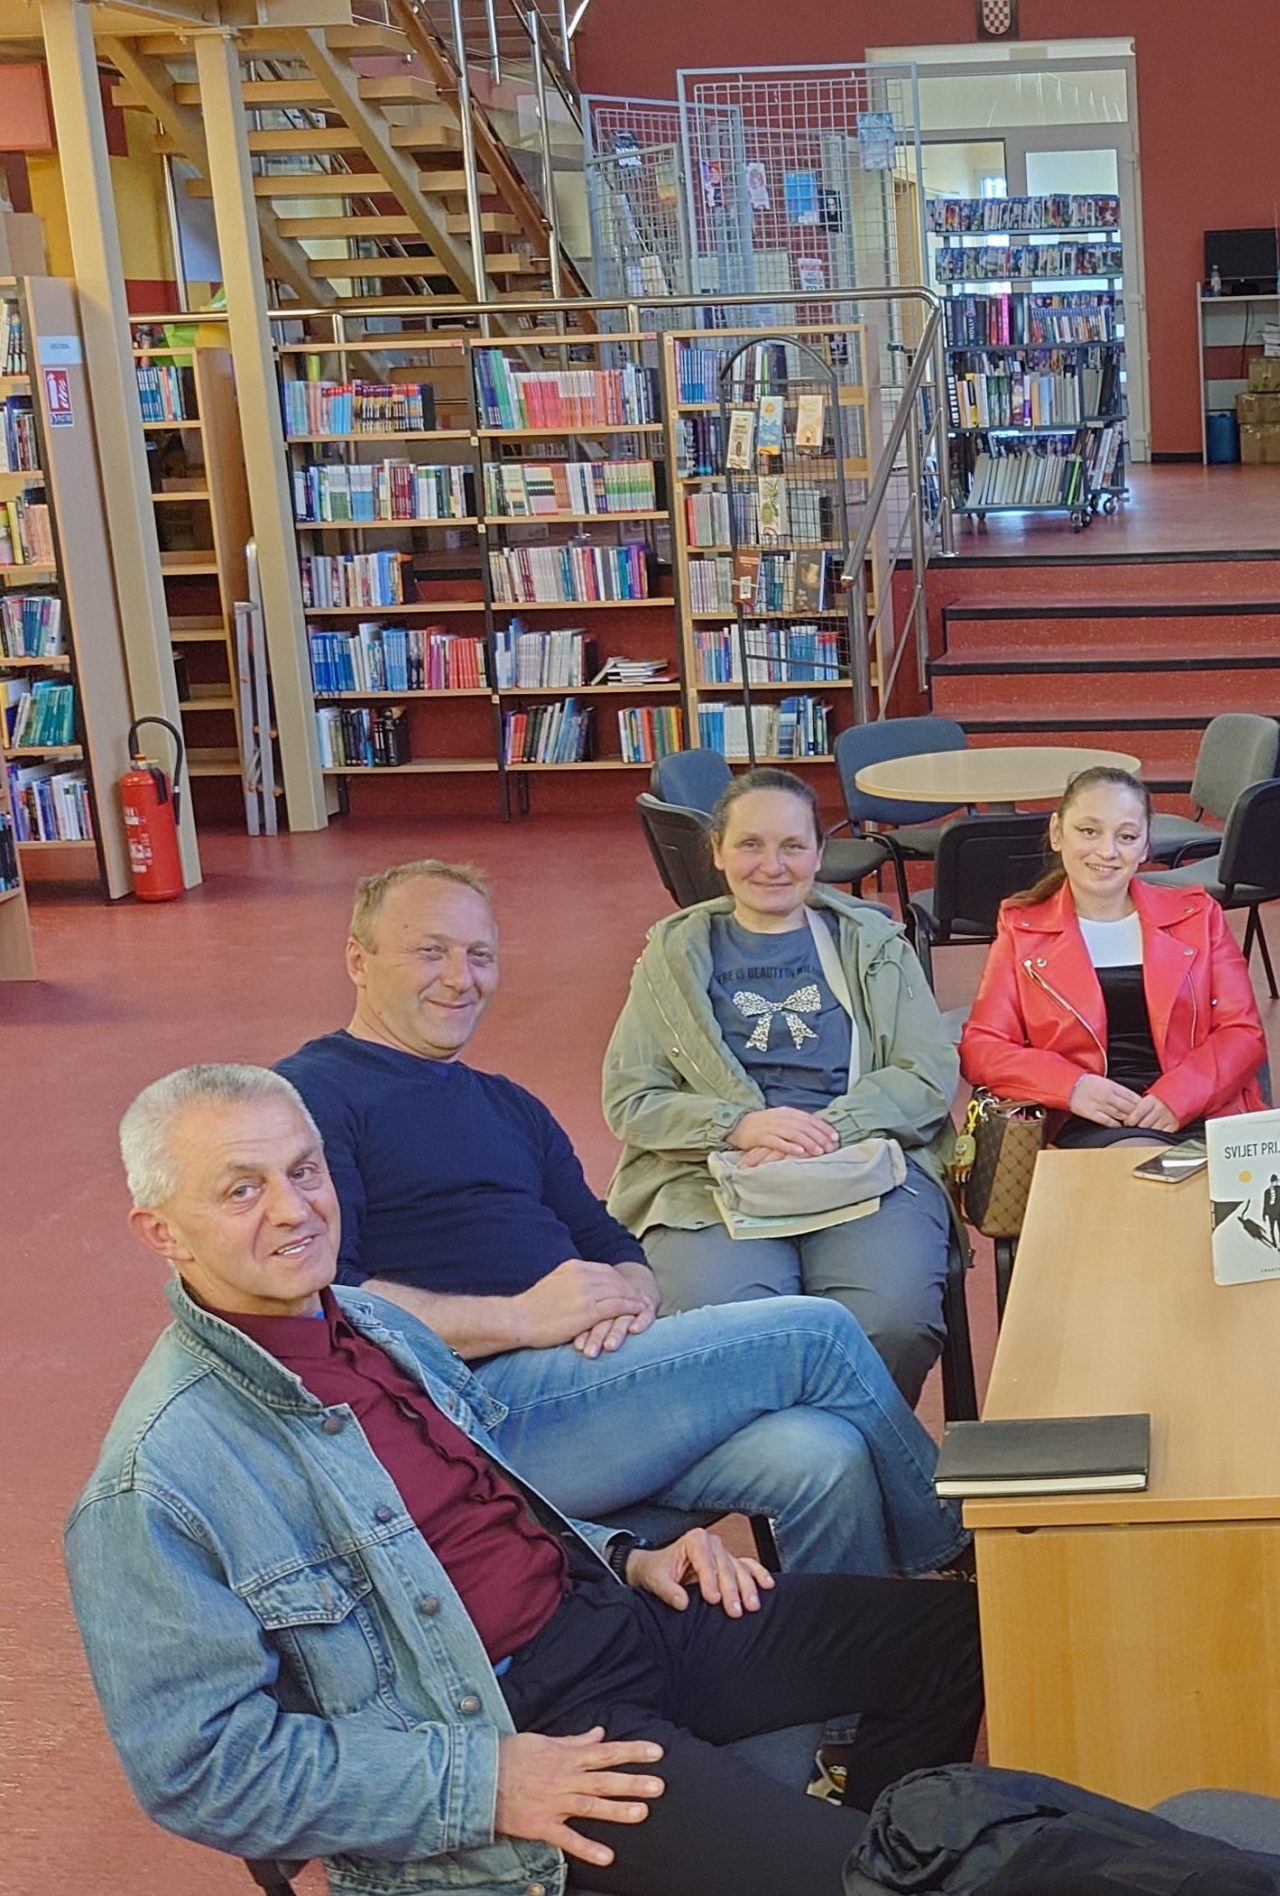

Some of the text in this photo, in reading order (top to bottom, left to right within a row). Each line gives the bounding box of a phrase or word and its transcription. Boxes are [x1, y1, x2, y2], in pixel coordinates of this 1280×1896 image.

[948, 376, 960, 423] MURAKAMI
[736, 968, 746, 980] IS
[1224, 1144, 1258, 1159] SVIJET
